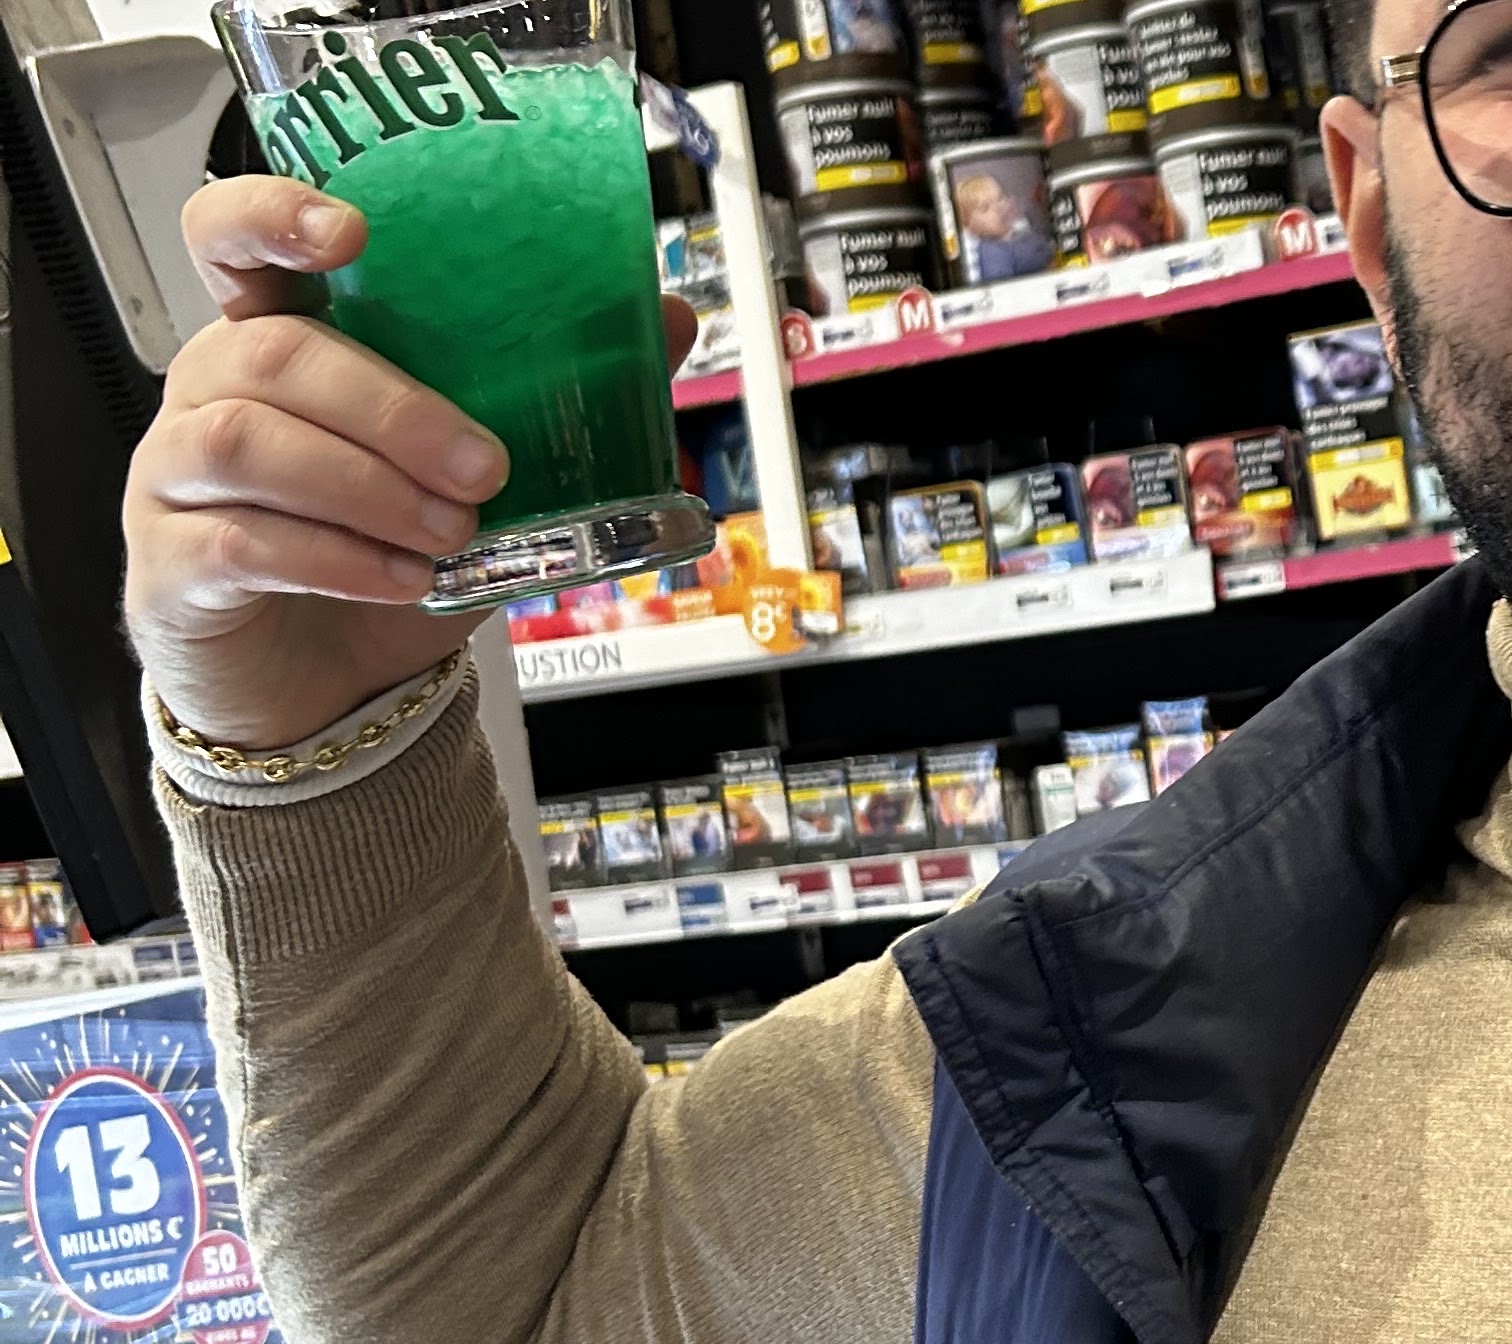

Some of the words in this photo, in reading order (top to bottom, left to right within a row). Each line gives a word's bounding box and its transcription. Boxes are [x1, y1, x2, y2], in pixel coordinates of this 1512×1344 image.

[824, 125, 854, 145] vos
[815, 142, 891, 169] poumons
[1215, 173, 1249, 194] vos
[1280, 221, 1314, 256] M
[857, 254, 889, 274] vos
[848, 270, 923, 297] poumons
[902, 300, 930, 333] M
[517, 641, 622, 682] USTION
[55, 1114, 161, 1221] 13
[60, 1219, 164, 1258] MILLIONS
[201, 1243, 238, 1276] 50
[84, 1271, 97, 1294] À
[99, 1263, 169, 1290] GAGNER
[186, 1304, 212, 1326] 20
